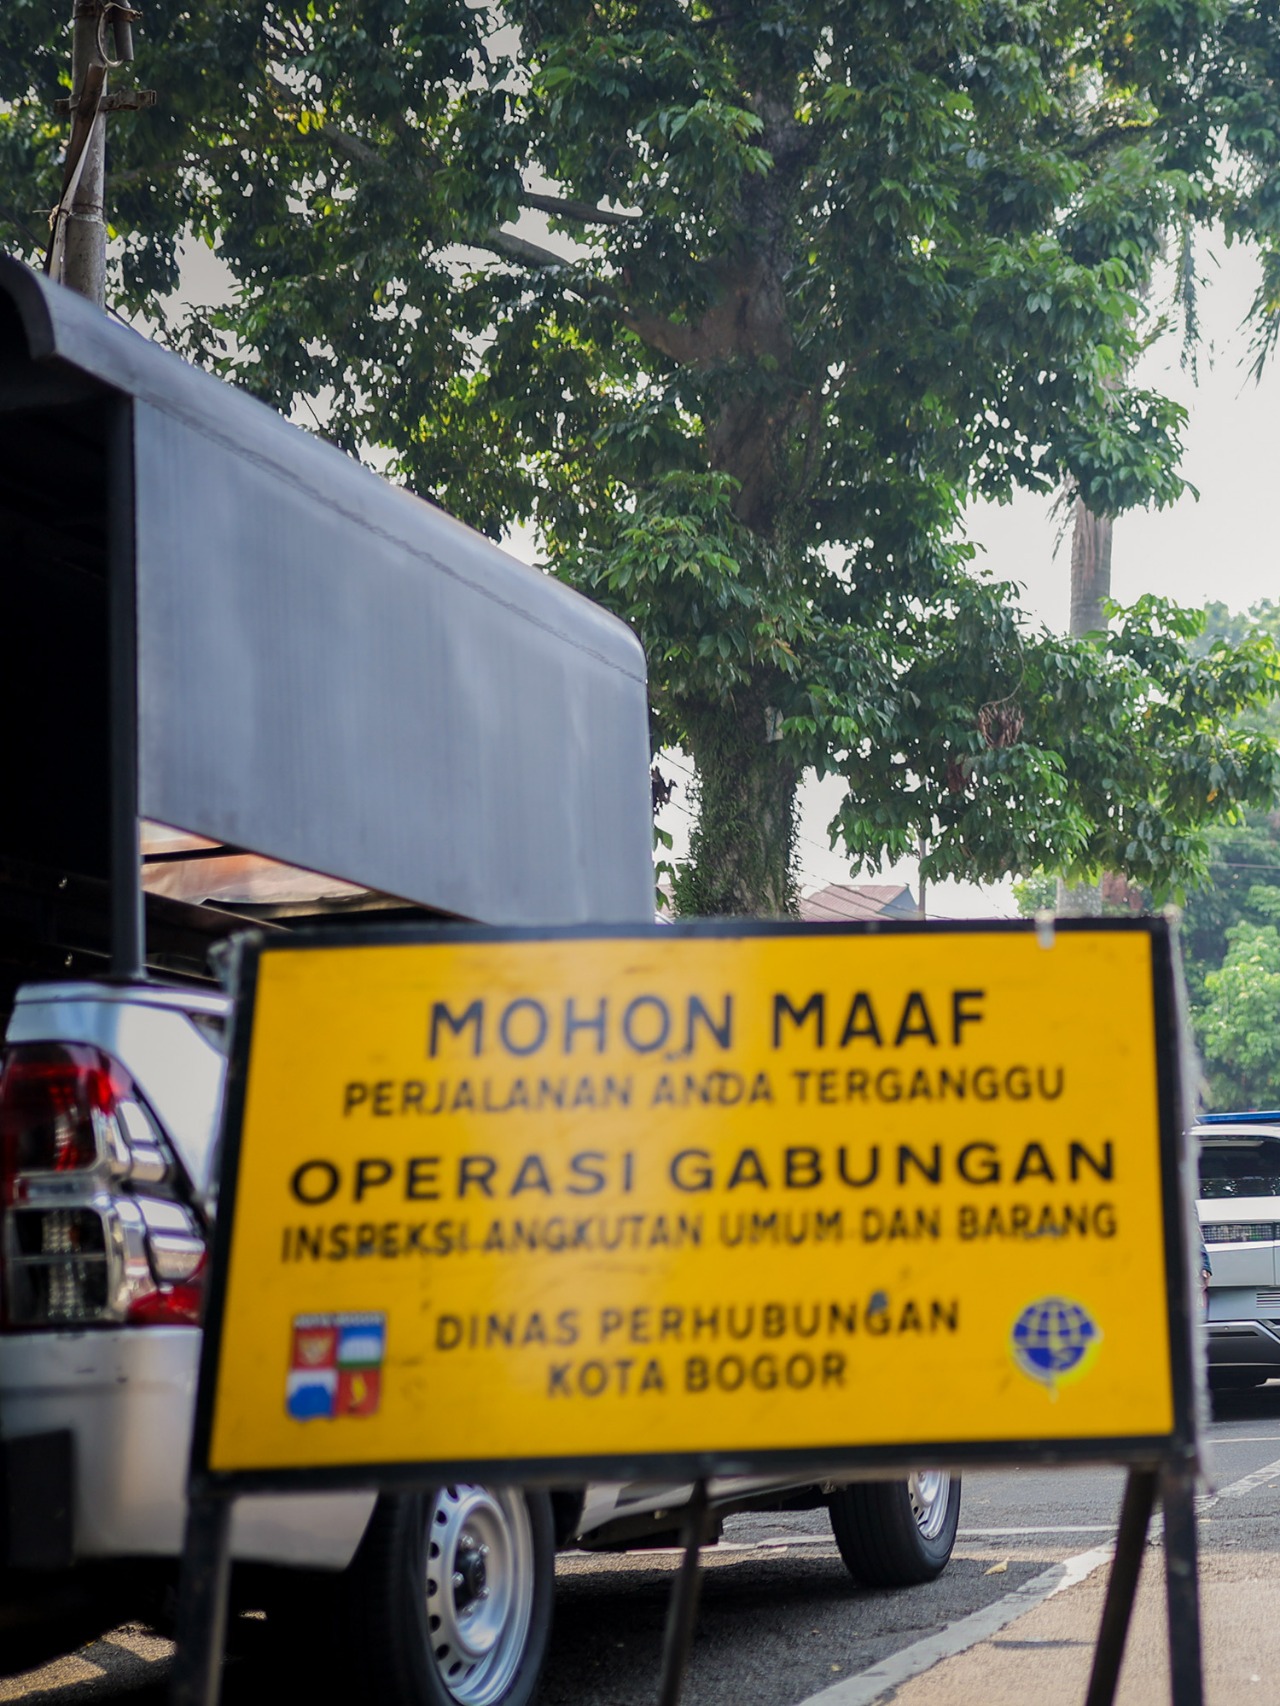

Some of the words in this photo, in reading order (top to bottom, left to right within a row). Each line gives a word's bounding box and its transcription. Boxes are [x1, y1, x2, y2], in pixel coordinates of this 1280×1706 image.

[427, 993, 734, 1060] MOHON
[771, 987, 988, 1051] MAAF
[342, 1075, 631, 1119] PERJALANAN
[651, 1070, 774, 1109] ANDA
[793, 1065, 1066, 1106] TERGANGGU
[286, 1150, 635, 1209] OPERASI
[666, 1137, 1117, 1194] GABUNGAN
[280, 1219, 470, 1265] INSPEKSI
[482, 1213, 704, 1256] ANGKUTAN
[719, 1208, 845, 1250] UMUM
[859, 1205, 944, 1247] DAN
[956, 1200, 1119, 1244] BARANG
[434, 1308, 582, 1354] DINAS
[600, 1300, 961, 1344] PERHUBUNGAN
[546, 1360, 666, 1399] KOTA
[685, 1352, 849, 1394] BOGOR
